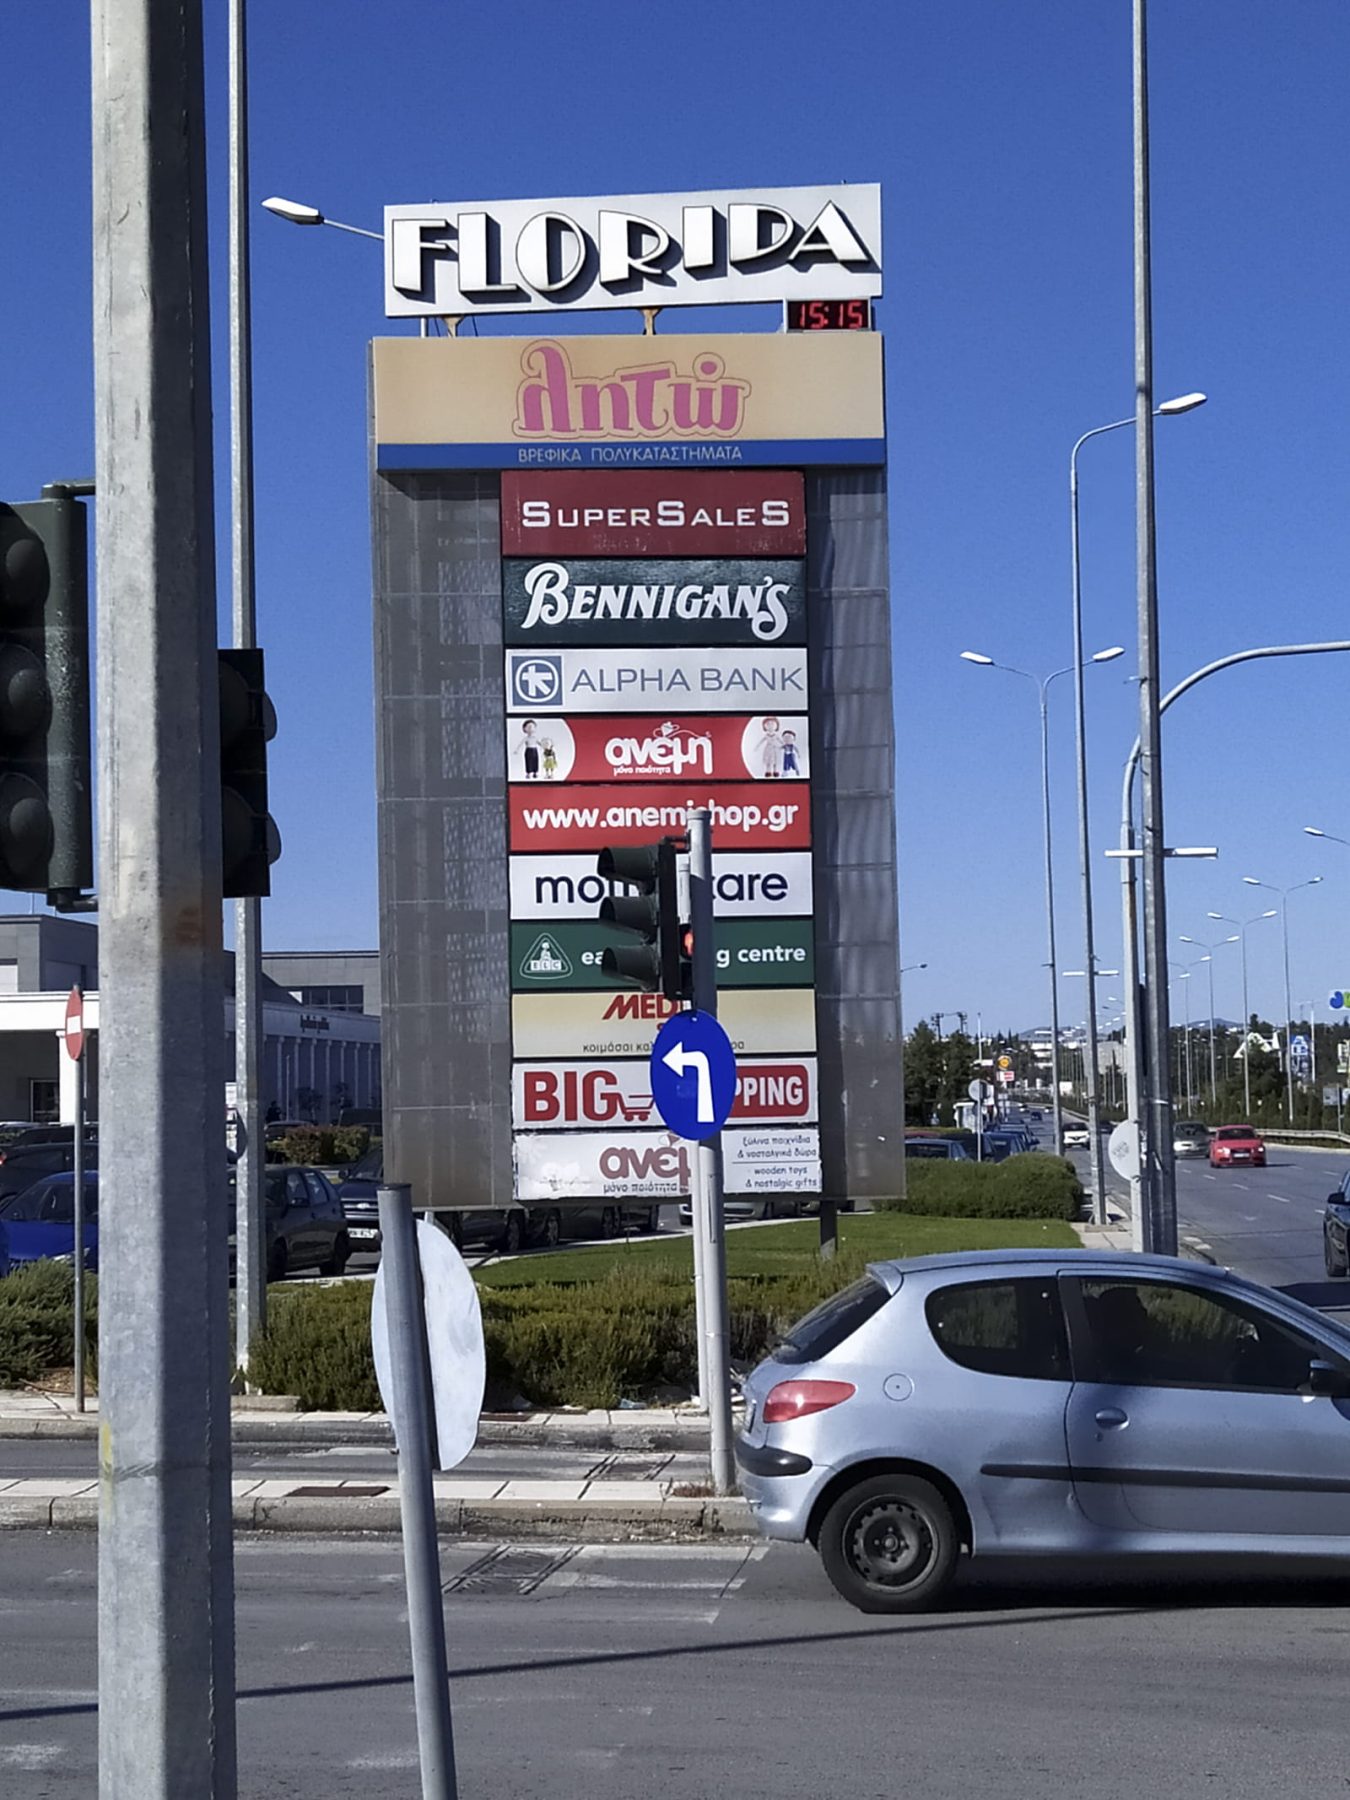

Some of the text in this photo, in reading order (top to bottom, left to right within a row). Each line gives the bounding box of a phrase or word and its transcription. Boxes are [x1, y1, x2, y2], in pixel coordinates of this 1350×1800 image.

[391, 200, 880, 303] FLORIDA
[799, 301, 863, 329] 15:15
[518, 446, 743, 463] ΒΡΕΦΙΚΑ ΠΟΛΥΚΑΤΑΣΤΗΜΑΤΑ
[520, 562, 791, 641] BENNIGAN'S
[571, 667, 805, 693] ALPHA BANK
[523, 798, 800, 833] www.anemhop.gr
[738, 945, 806, 962] centre
[583, 1041, 633, 1055] κοιμάσαι
[523, 1070, 618, 1122] BIG
[754, 1166, 808, 1176] wooden toys
[603, 1181, 678, 1193] μόνο ποιότητα
[754, 1178, 793, 1189] nostalgic
[795, 1177, 817, 1189] gifts
